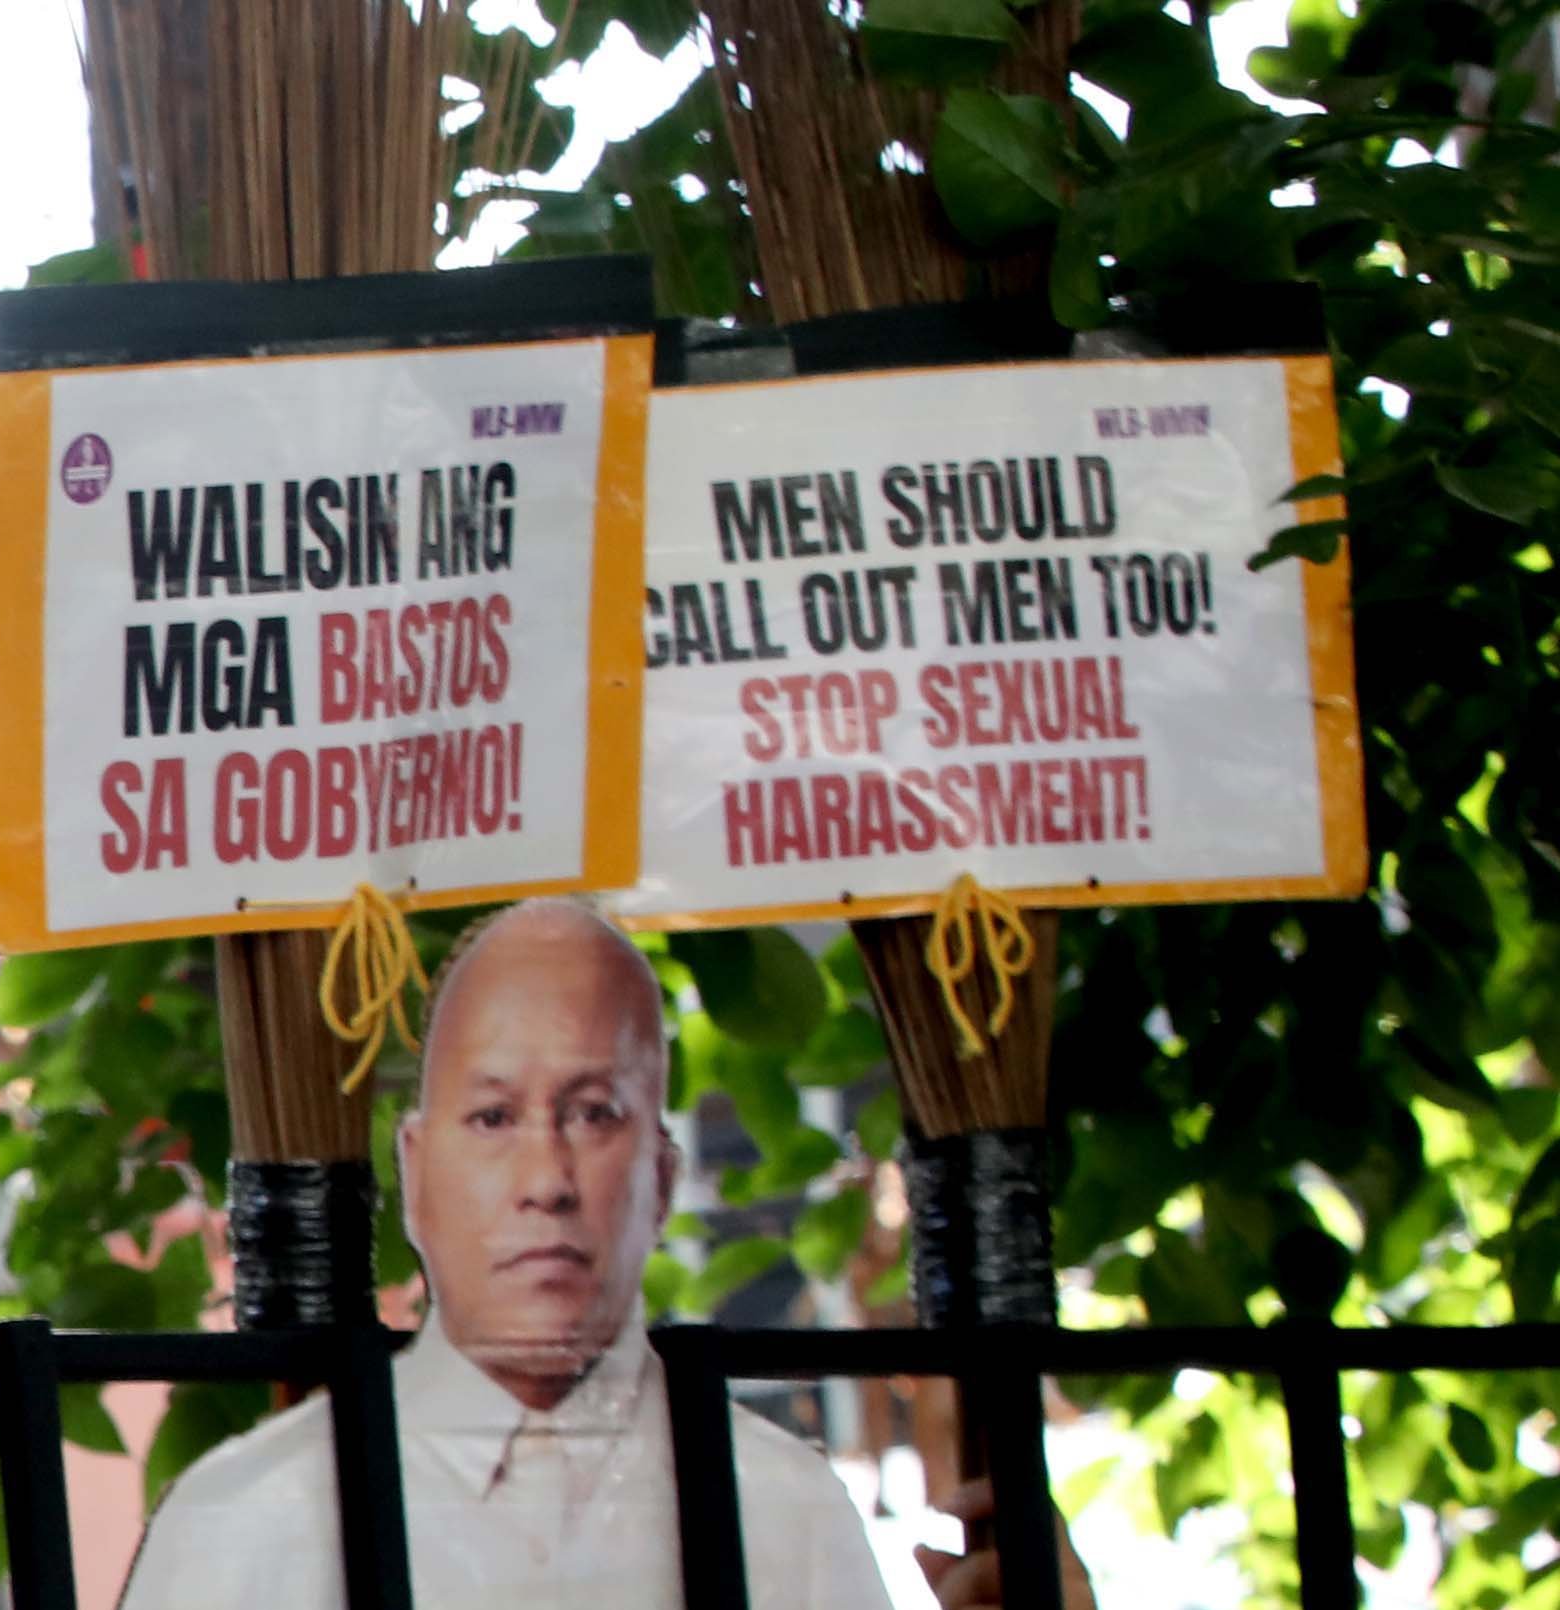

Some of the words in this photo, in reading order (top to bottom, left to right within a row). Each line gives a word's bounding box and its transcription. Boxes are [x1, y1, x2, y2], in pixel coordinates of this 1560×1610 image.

[127, 472, 399, 600] WALISIN
[418, 462, 516, 579] ANG
[710, 470, 865, 563] MEN
[882, 455, 1116, 549] SHOULD
[800, 566, 916, 655] OUT
[938, 557, 1078, 648] MEN
[1092, 553, 1217, 640] TOO!
[123, 616, 295, 737] MGA
[320, 594, 511, 724] BASTOS
[740, 670, 898, 763] STOP
[919, 656, 1140, 749] SEXUAL
[101, 758, 189, 874] SA
[213, 723, 523, 864] GOBYERNO!
[723, 756, 1151, 869] HARASSMENT!
